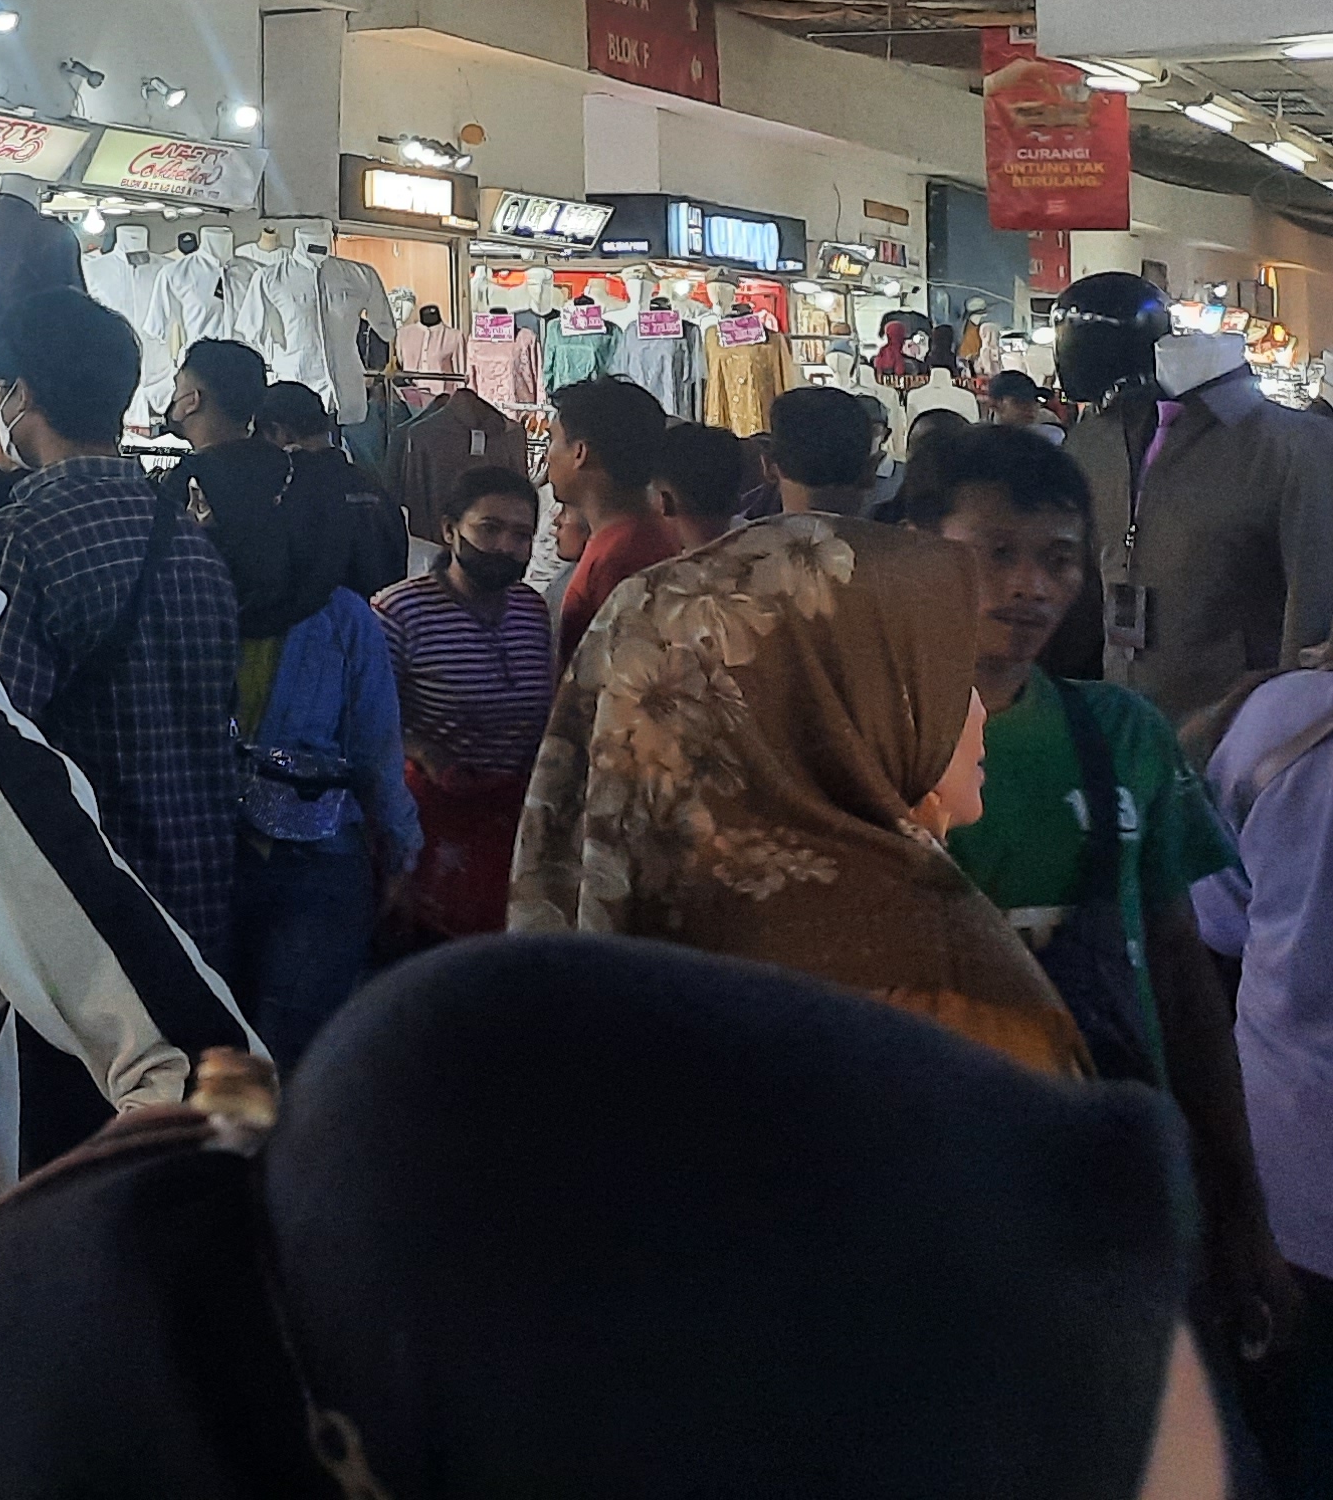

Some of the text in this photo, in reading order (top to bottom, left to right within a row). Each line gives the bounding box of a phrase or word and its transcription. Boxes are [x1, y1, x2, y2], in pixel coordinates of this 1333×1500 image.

[607, 31, 640, 68] BLOK
[1003, 161, 1106, 175] UNTUNG TAK
